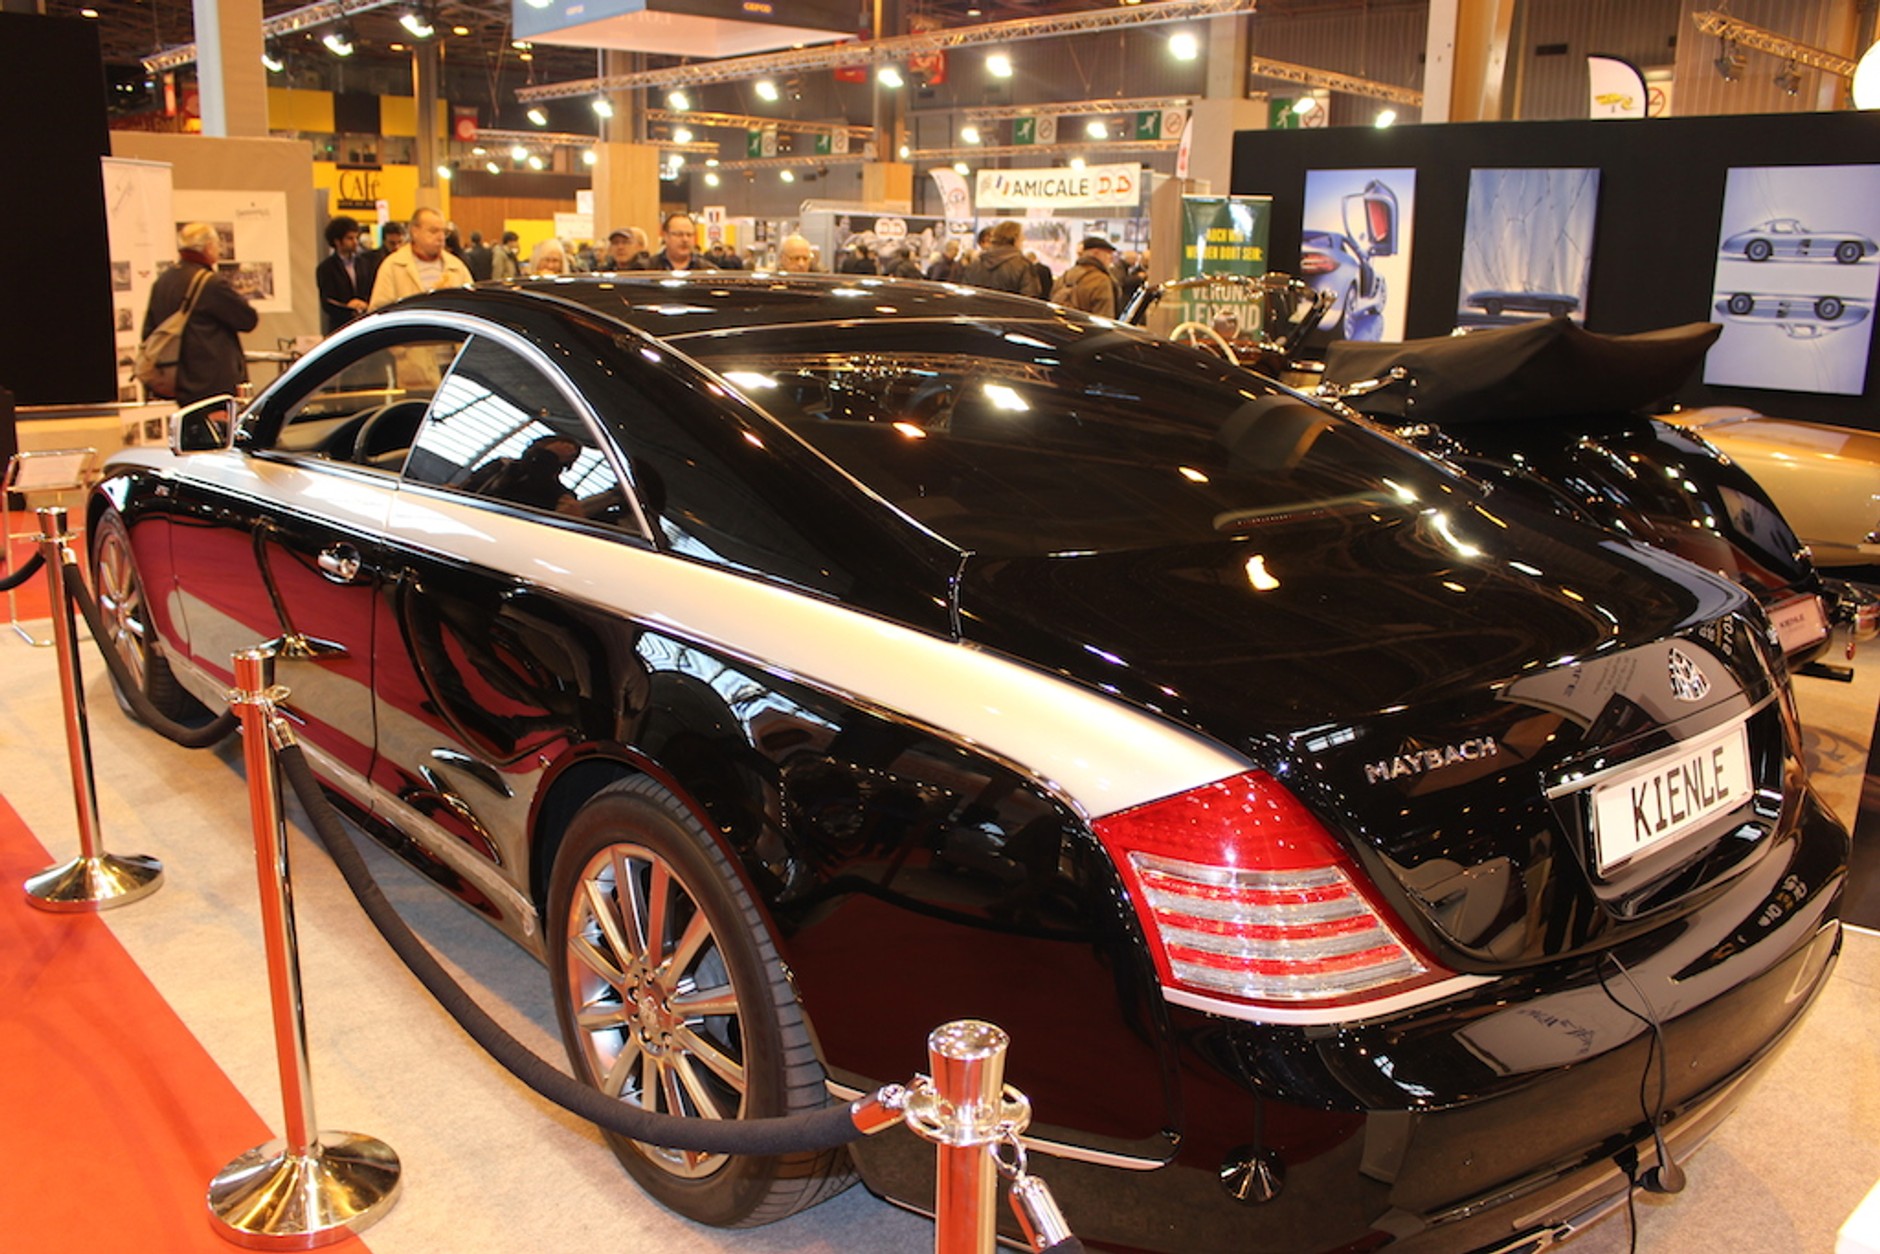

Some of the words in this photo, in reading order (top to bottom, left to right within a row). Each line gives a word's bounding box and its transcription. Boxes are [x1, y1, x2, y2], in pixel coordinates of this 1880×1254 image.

[1012, 177, 1090, 198] AMICALE
[1363, 735, 1499, 785] MAYBACH
[1630, 745, 1730, 842] KIENLE
